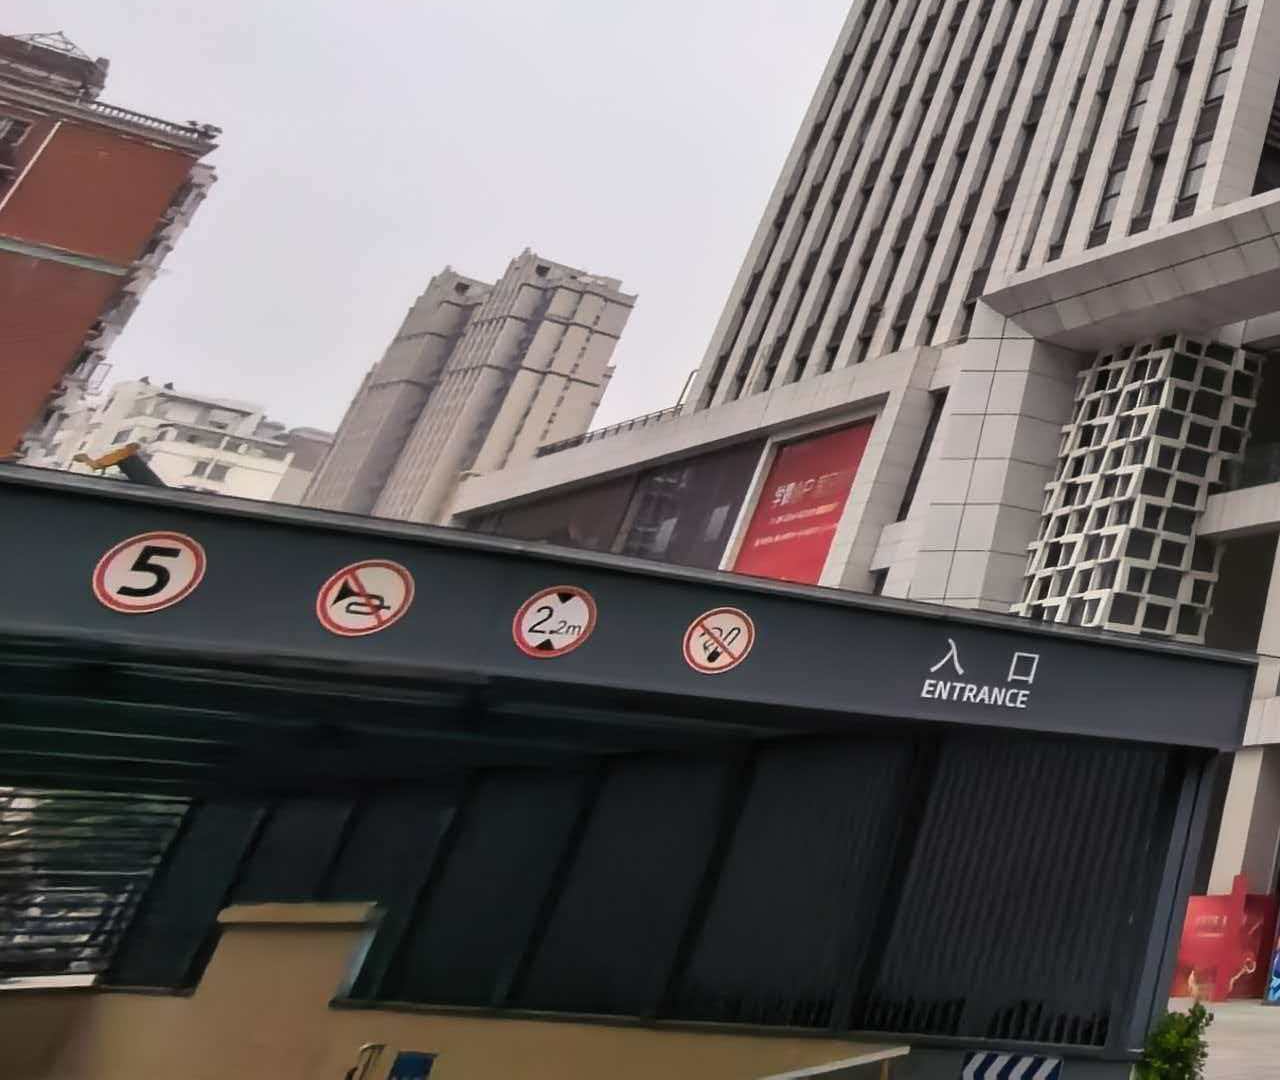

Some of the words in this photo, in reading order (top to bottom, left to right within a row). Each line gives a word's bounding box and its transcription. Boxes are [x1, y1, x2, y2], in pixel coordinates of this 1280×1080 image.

[116, 545, 181, 597] 5
[528, 606, 582, 635] 2.2m
[930, 638, 1039, 684] 入口
[921, 679, 1030, 708] ENTRANCE
